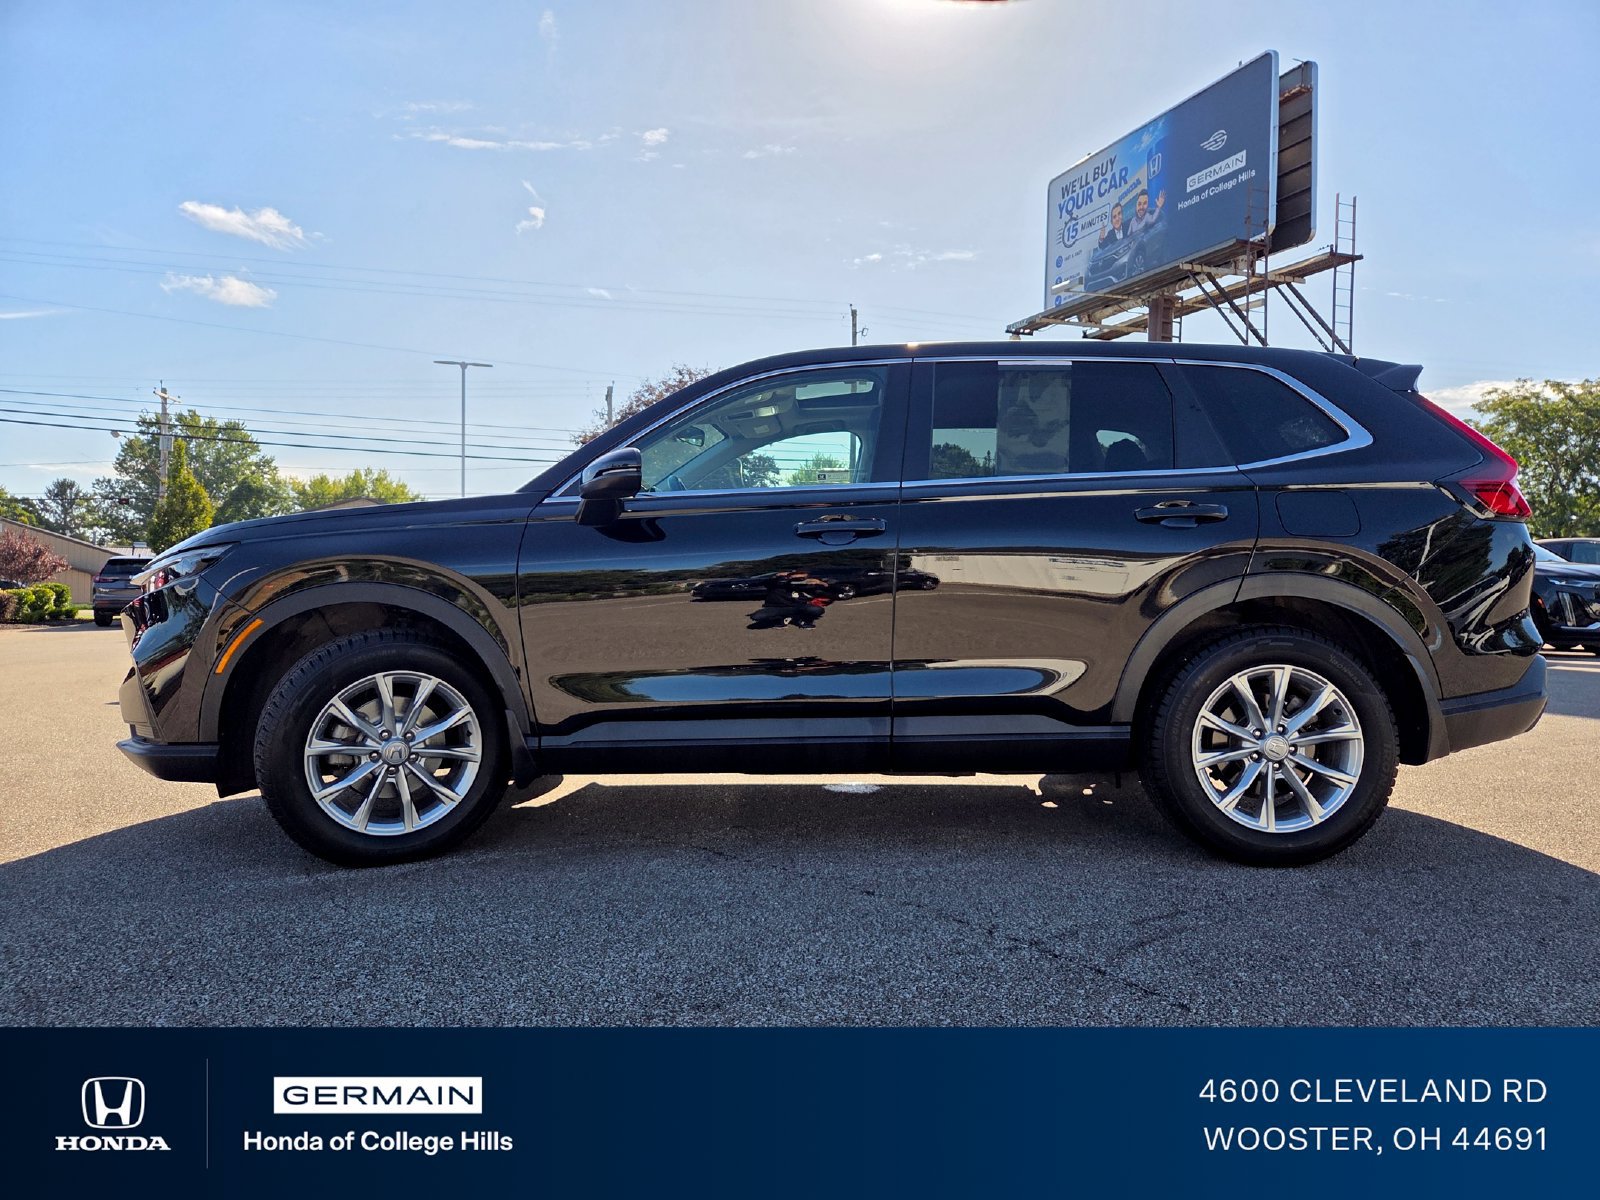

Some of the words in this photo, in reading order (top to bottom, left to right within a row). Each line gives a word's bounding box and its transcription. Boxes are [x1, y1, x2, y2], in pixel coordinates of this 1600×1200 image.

[1061, 172, 1090, 199] WE'LL
[1093, 154, 1117, 182] BUY
[1177, 195, 1200, 210] Honda
[1201, 189, 1209, 200] of
[1209, 178, 1237, 196] College
[1238, 169, 1256, 183] Hills
[1188, 154, 1244, 188] GERMAIN
[1058, 185, 1094, 219] YOUR
[1098, 166, 1129, 198] CAR
[1066, 221, 1079, 242] 15
[1080, 211, 1108, 232] MINUTES
